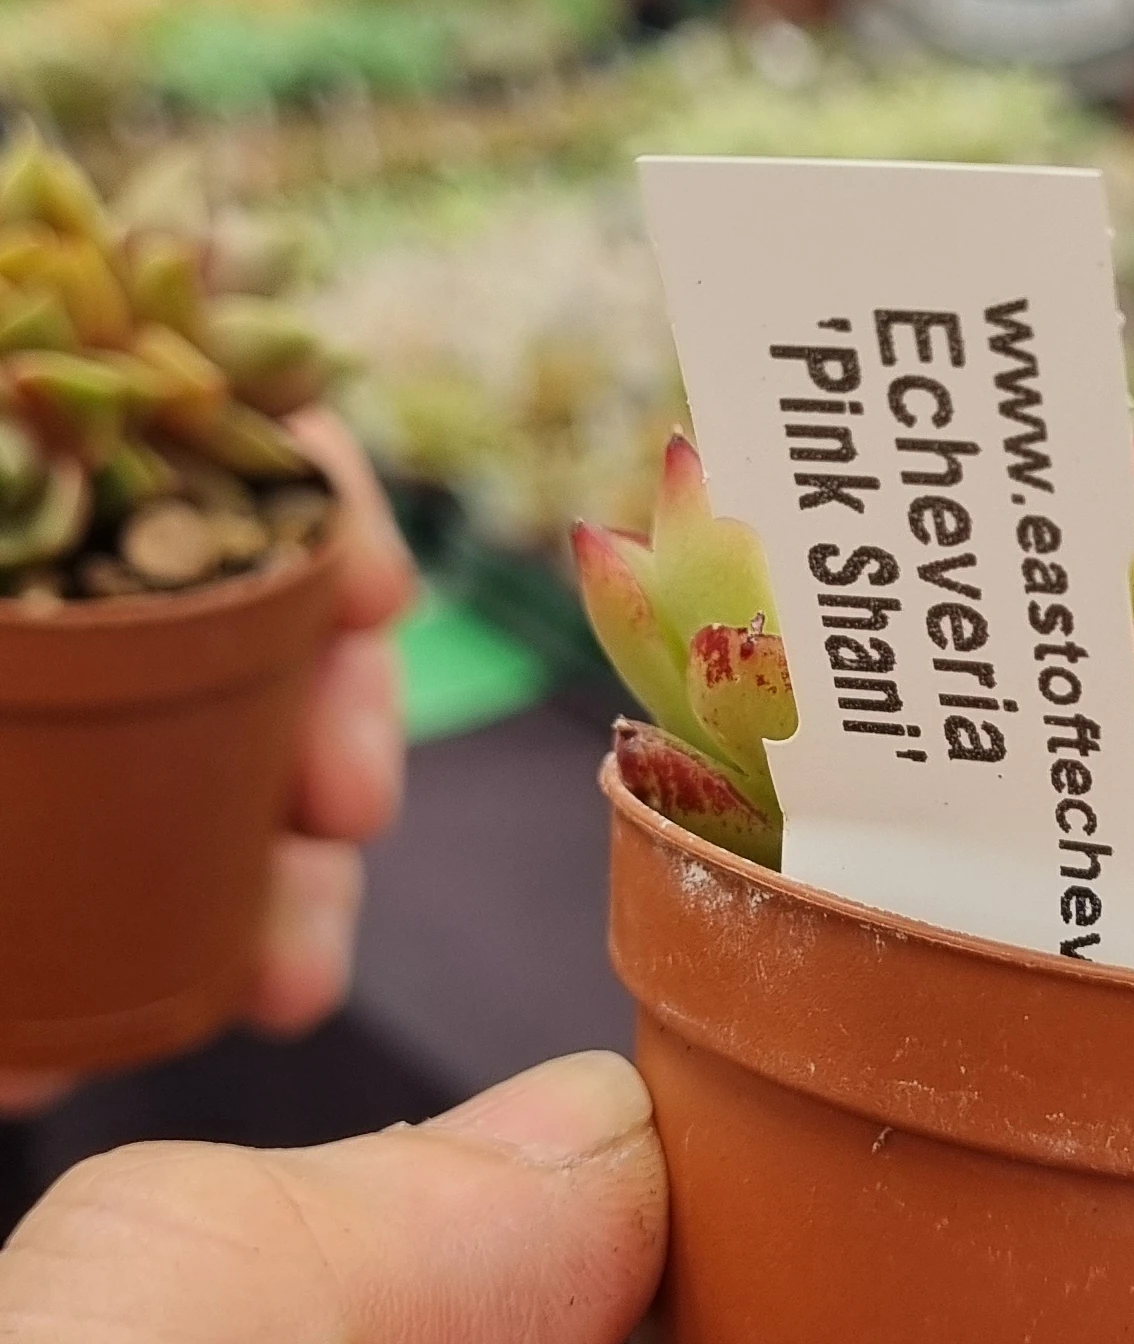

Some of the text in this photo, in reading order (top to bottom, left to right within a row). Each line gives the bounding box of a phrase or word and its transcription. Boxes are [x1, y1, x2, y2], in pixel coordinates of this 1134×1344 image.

[769, 317, 928, 763] 'Pink Shani'
[872, 307, 1018, 764] Echeveria
